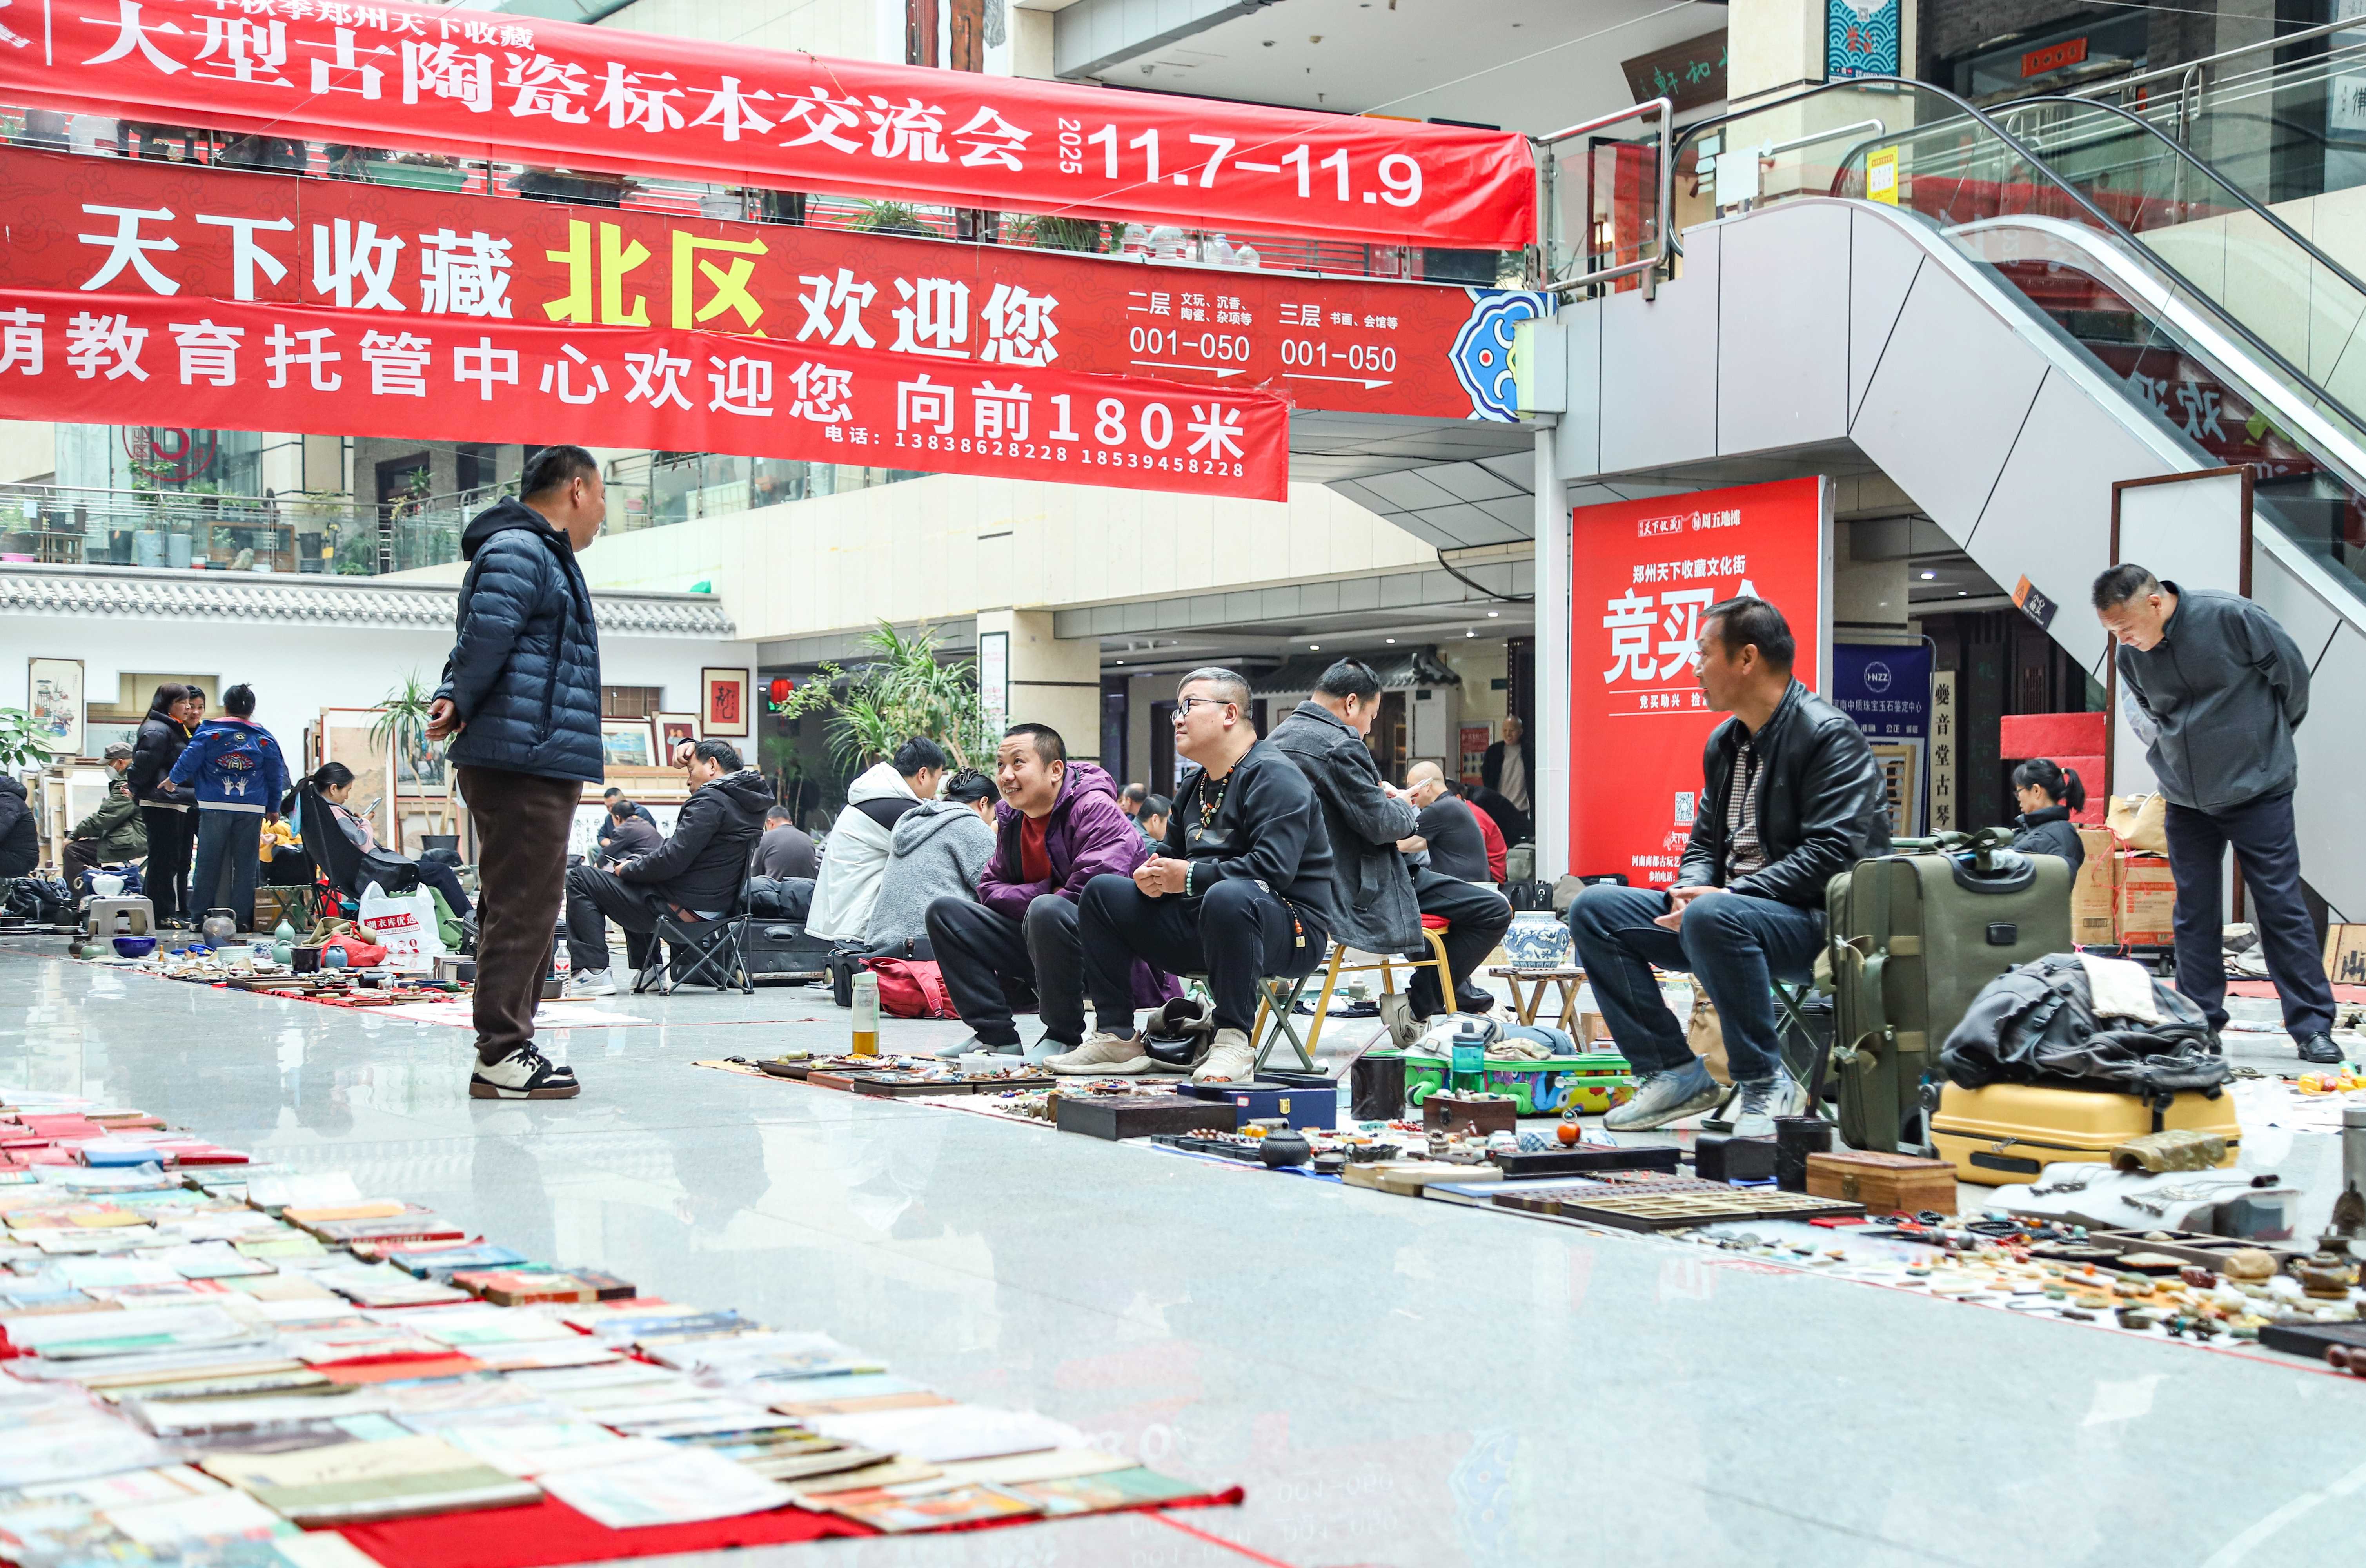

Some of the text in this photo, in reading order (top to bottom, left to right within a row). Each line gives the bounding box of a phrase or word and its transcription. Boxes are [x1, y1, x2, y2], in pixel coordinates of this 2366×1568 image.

[80, 2, 1033, 172] 大型古陶瓷标本交流会
[1057, 117, 1083, 175] 2025
[78, 204, 1060, 367] 天下收藏 北区 欢迎您
[1127, 291, 1172, 316] 二层
[1180, 307, 1253, 326] 陶瓷、杂项等
[1278, 303, 1322, 328] 三层
[1329, 312, 1398, 330] 书画、会馆等
[896, 374, 1245, 460] 向前180米
[895, 432, 1068, 462] 13838628228
[1081, 449, 1244, 477] 18539458228
[1632, 554, 1746, 584] 郑州天下收藏文化街
[1603, 579, 1761, 684] 竞买
[1639, 692, 1708, 709] 竞买助兴 捡
[1631, 855, 1681, 868] 河南商都古玩艺
